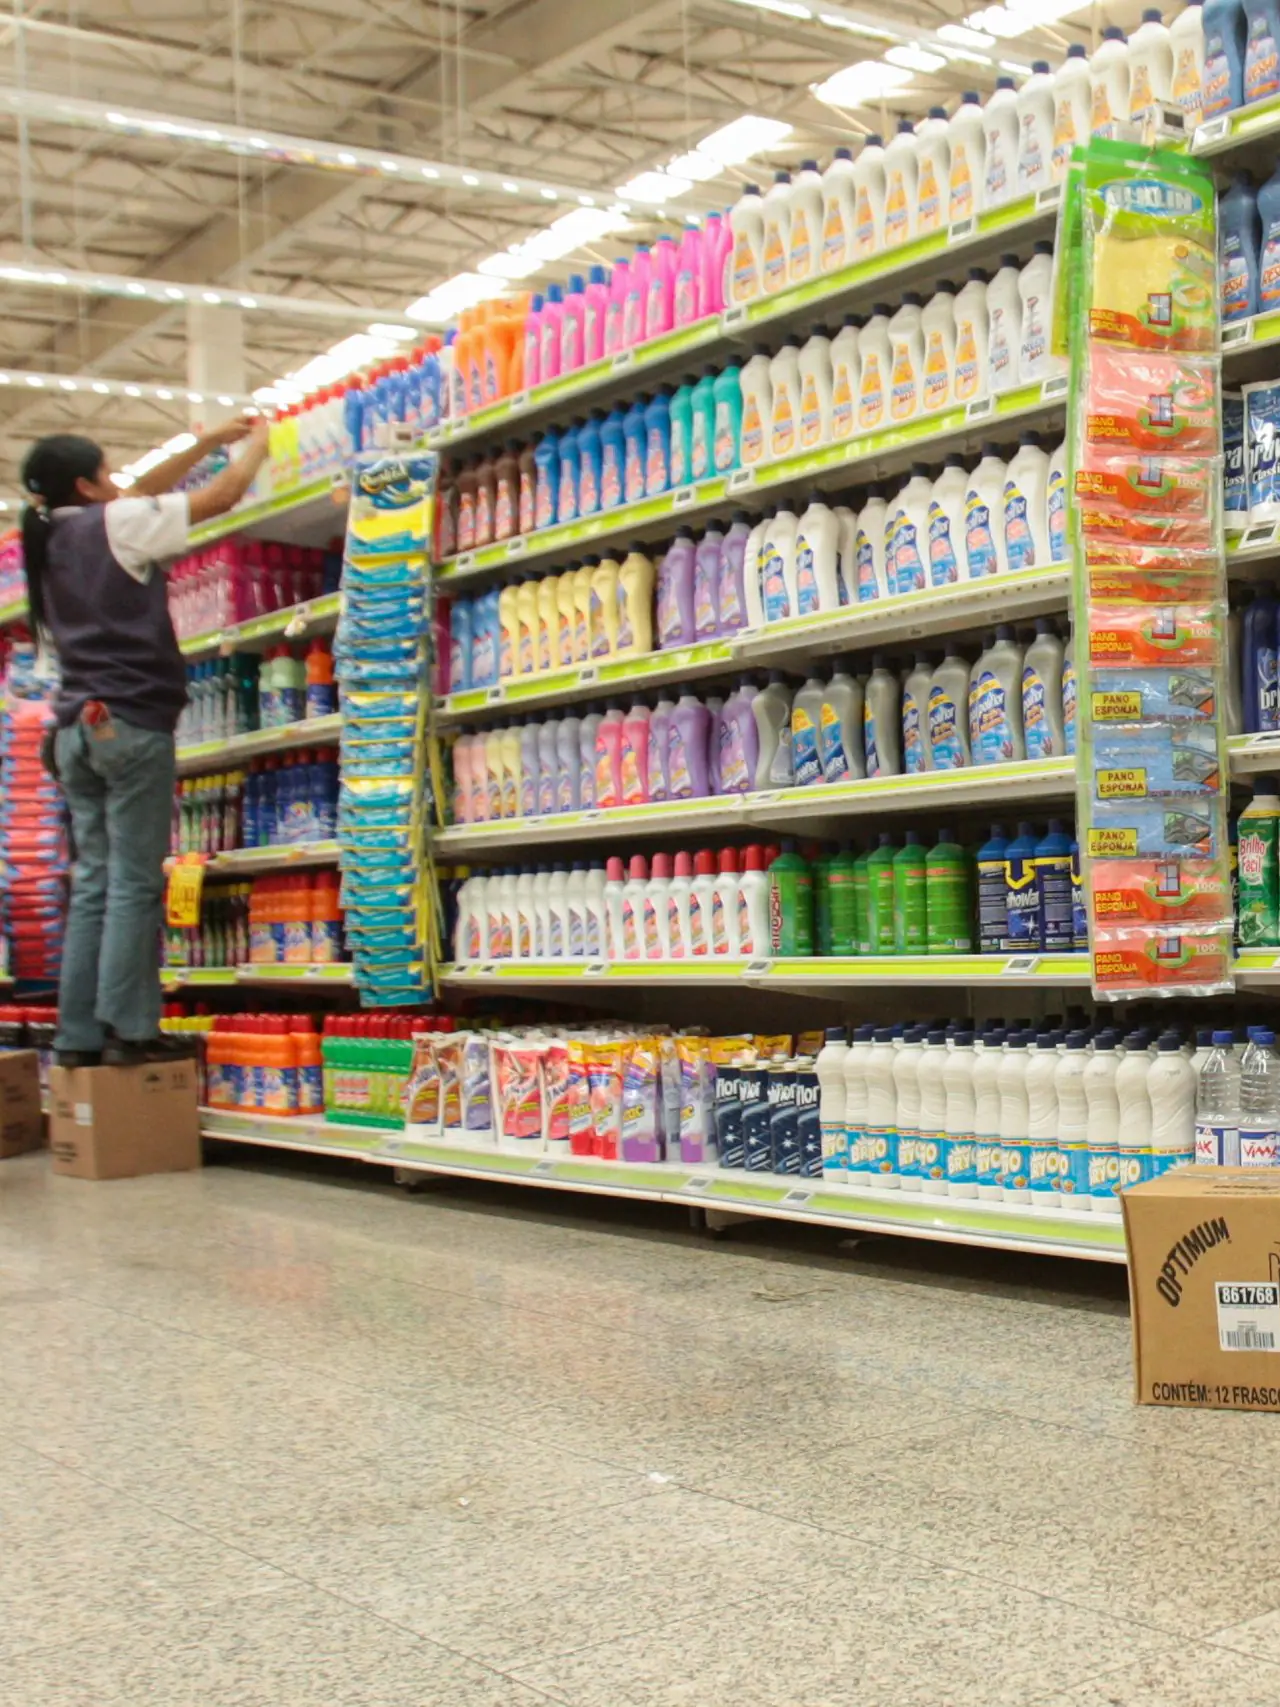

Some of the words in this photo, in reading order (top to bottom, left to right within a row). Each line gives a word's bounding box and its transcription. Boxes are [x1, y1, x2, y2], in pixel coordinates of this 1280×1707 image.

[1103, 695, 1130, 704] PANO
[1095, 704, 1139, 716] ESPONJA
[1108, 771, 1134, 781] PANO
[1100, 782, 1143, 793] ESPONJA
[1099, 831, 1125, 841] PANO
[1091, 841, 1134, 852] ESPONJA
[1240, 835, 1265, 855] Brilho
[1096, 891, 1122, 902] PANO
[1096, 900, 1138, 913] ESPONJA
[1096, 953, 1122, 964] PANO
[1096, 962, 1138, 974] ESPONJA
[1155, 1216, 1230, 1308] OPTIMUM
[1221, 1286, 1274, 1304] 861768
[1152, 1381, 1211, 1403] CONTÉM:
[1215, 1388, 1229, 1404] 12
